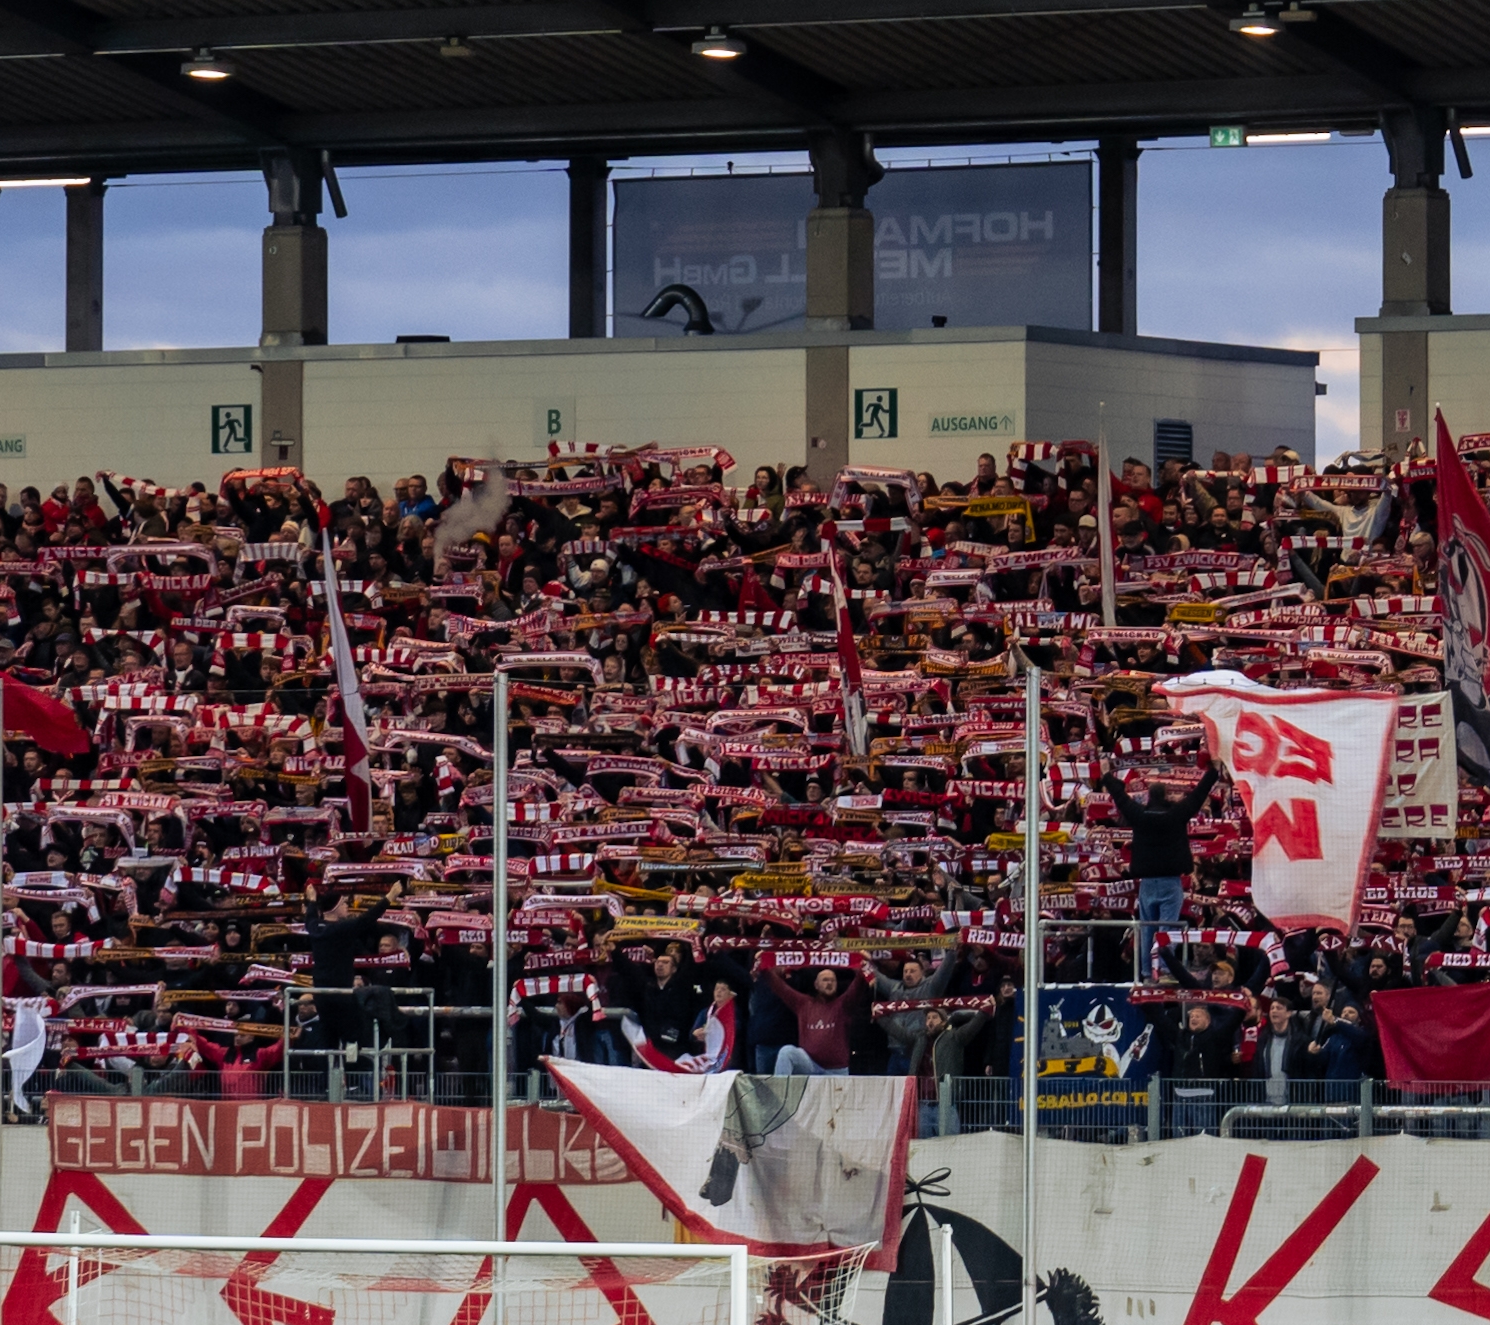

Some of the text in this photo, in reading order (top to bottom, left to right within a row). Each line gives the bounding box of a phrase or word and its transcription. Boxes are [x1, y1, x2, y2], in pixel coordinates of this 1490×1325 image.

[546, 408, 562, 436] B
[930, 415, 998, 435] AUSGANG
[558, 824, 647, 839] FSV ZWICKAU
[967, 929, 995, 944] RED
[775, 952, 805, 966] RED
[54, 1101, 216, 1170] GEGEN
